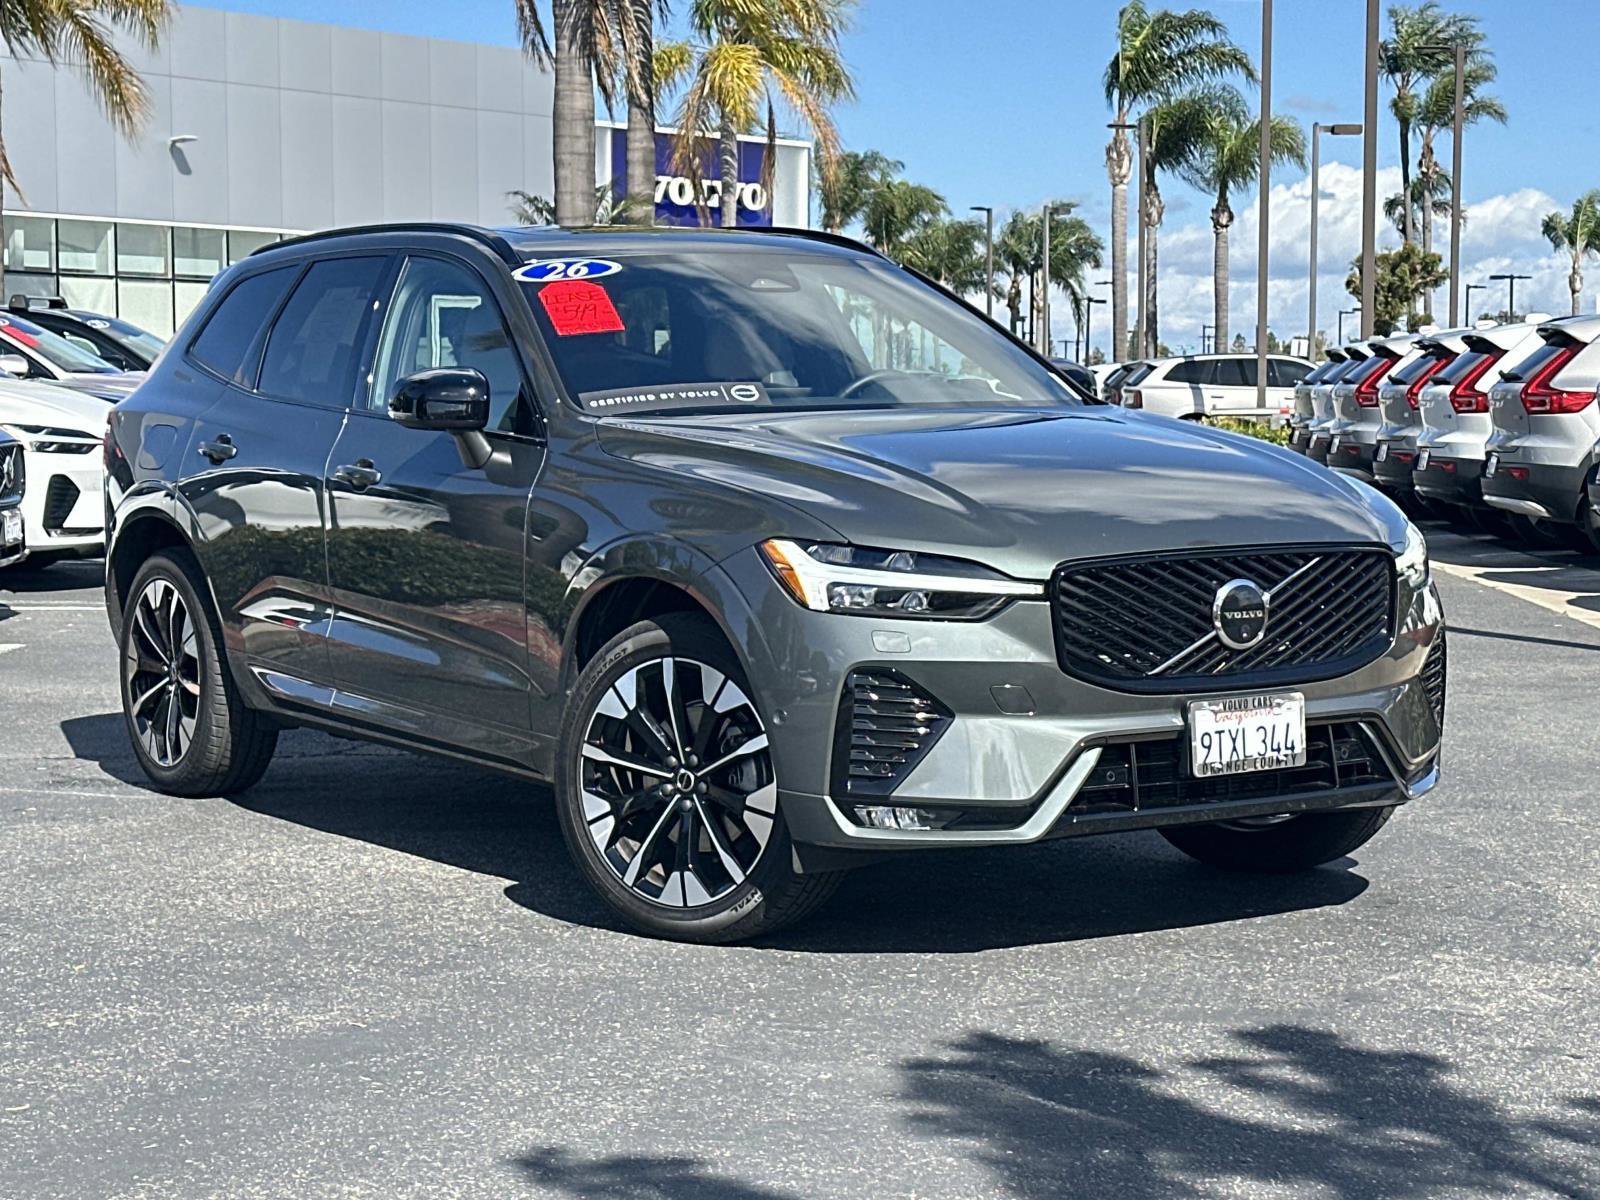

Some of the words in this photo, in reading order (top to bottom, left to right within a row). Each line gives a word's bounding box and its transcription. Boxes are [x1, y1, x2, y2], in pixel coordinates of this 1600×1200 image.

[541, 262, 589, 279] 26
[589, 394, 656, 408] CERTIFIED
[679, 390, 719, 398] VOLVO
[1224, 610, 1263, 619] VOLVO
[1222, 699, 1248, 711] VOLVO
[1252, 696, 1274, 708] CARS
[1200, 722, 1296, 764] 9TXL344
[1202, 760, 1249, 775] ORANGE
